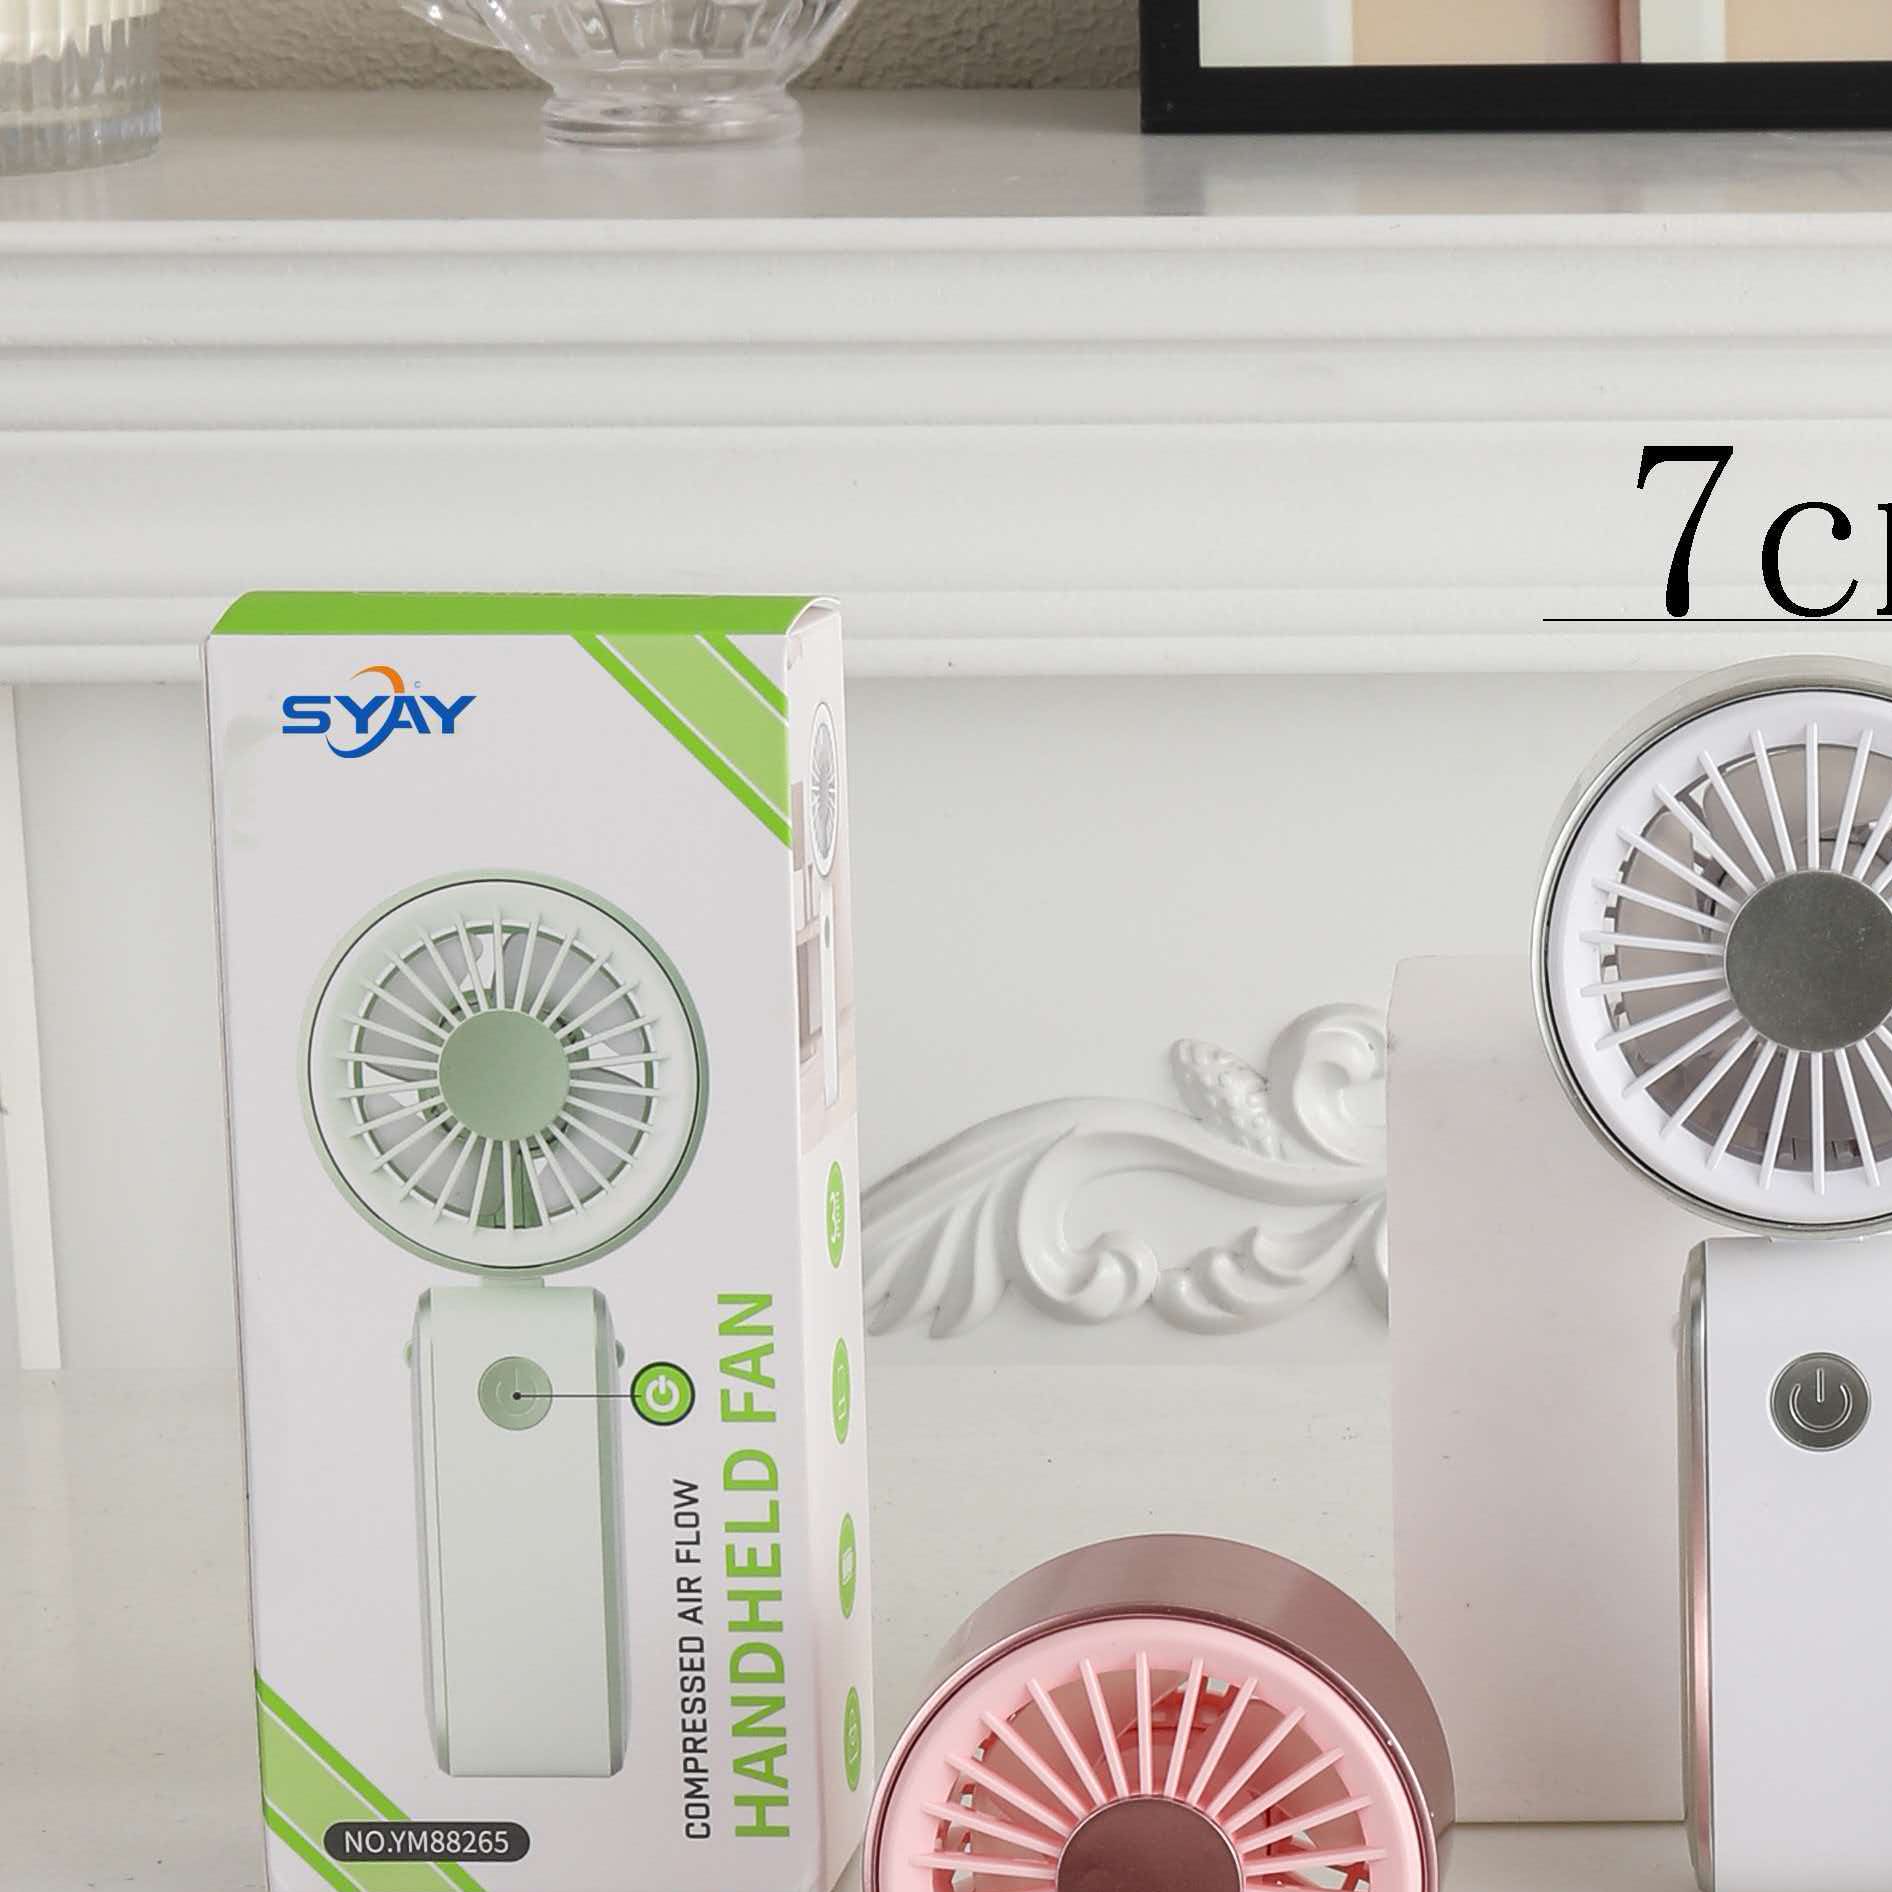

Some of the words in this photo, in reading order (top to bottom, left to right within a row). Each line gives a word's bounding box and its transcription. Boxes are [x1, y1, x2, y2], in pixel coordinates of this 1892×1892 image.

[282, 694, 476, 758] SYAY
[717, 1294, 776, 1422] FAN
[673, 1479, 702, 1564] FLOW
[676, 1576, 704, 1625] AIR
[722, 1449, 790, 1837] HANDHELD
[678, 1636, 711, 1840] COMPRESSED
[344, 1829, 510, 1855] NO.YM88265
